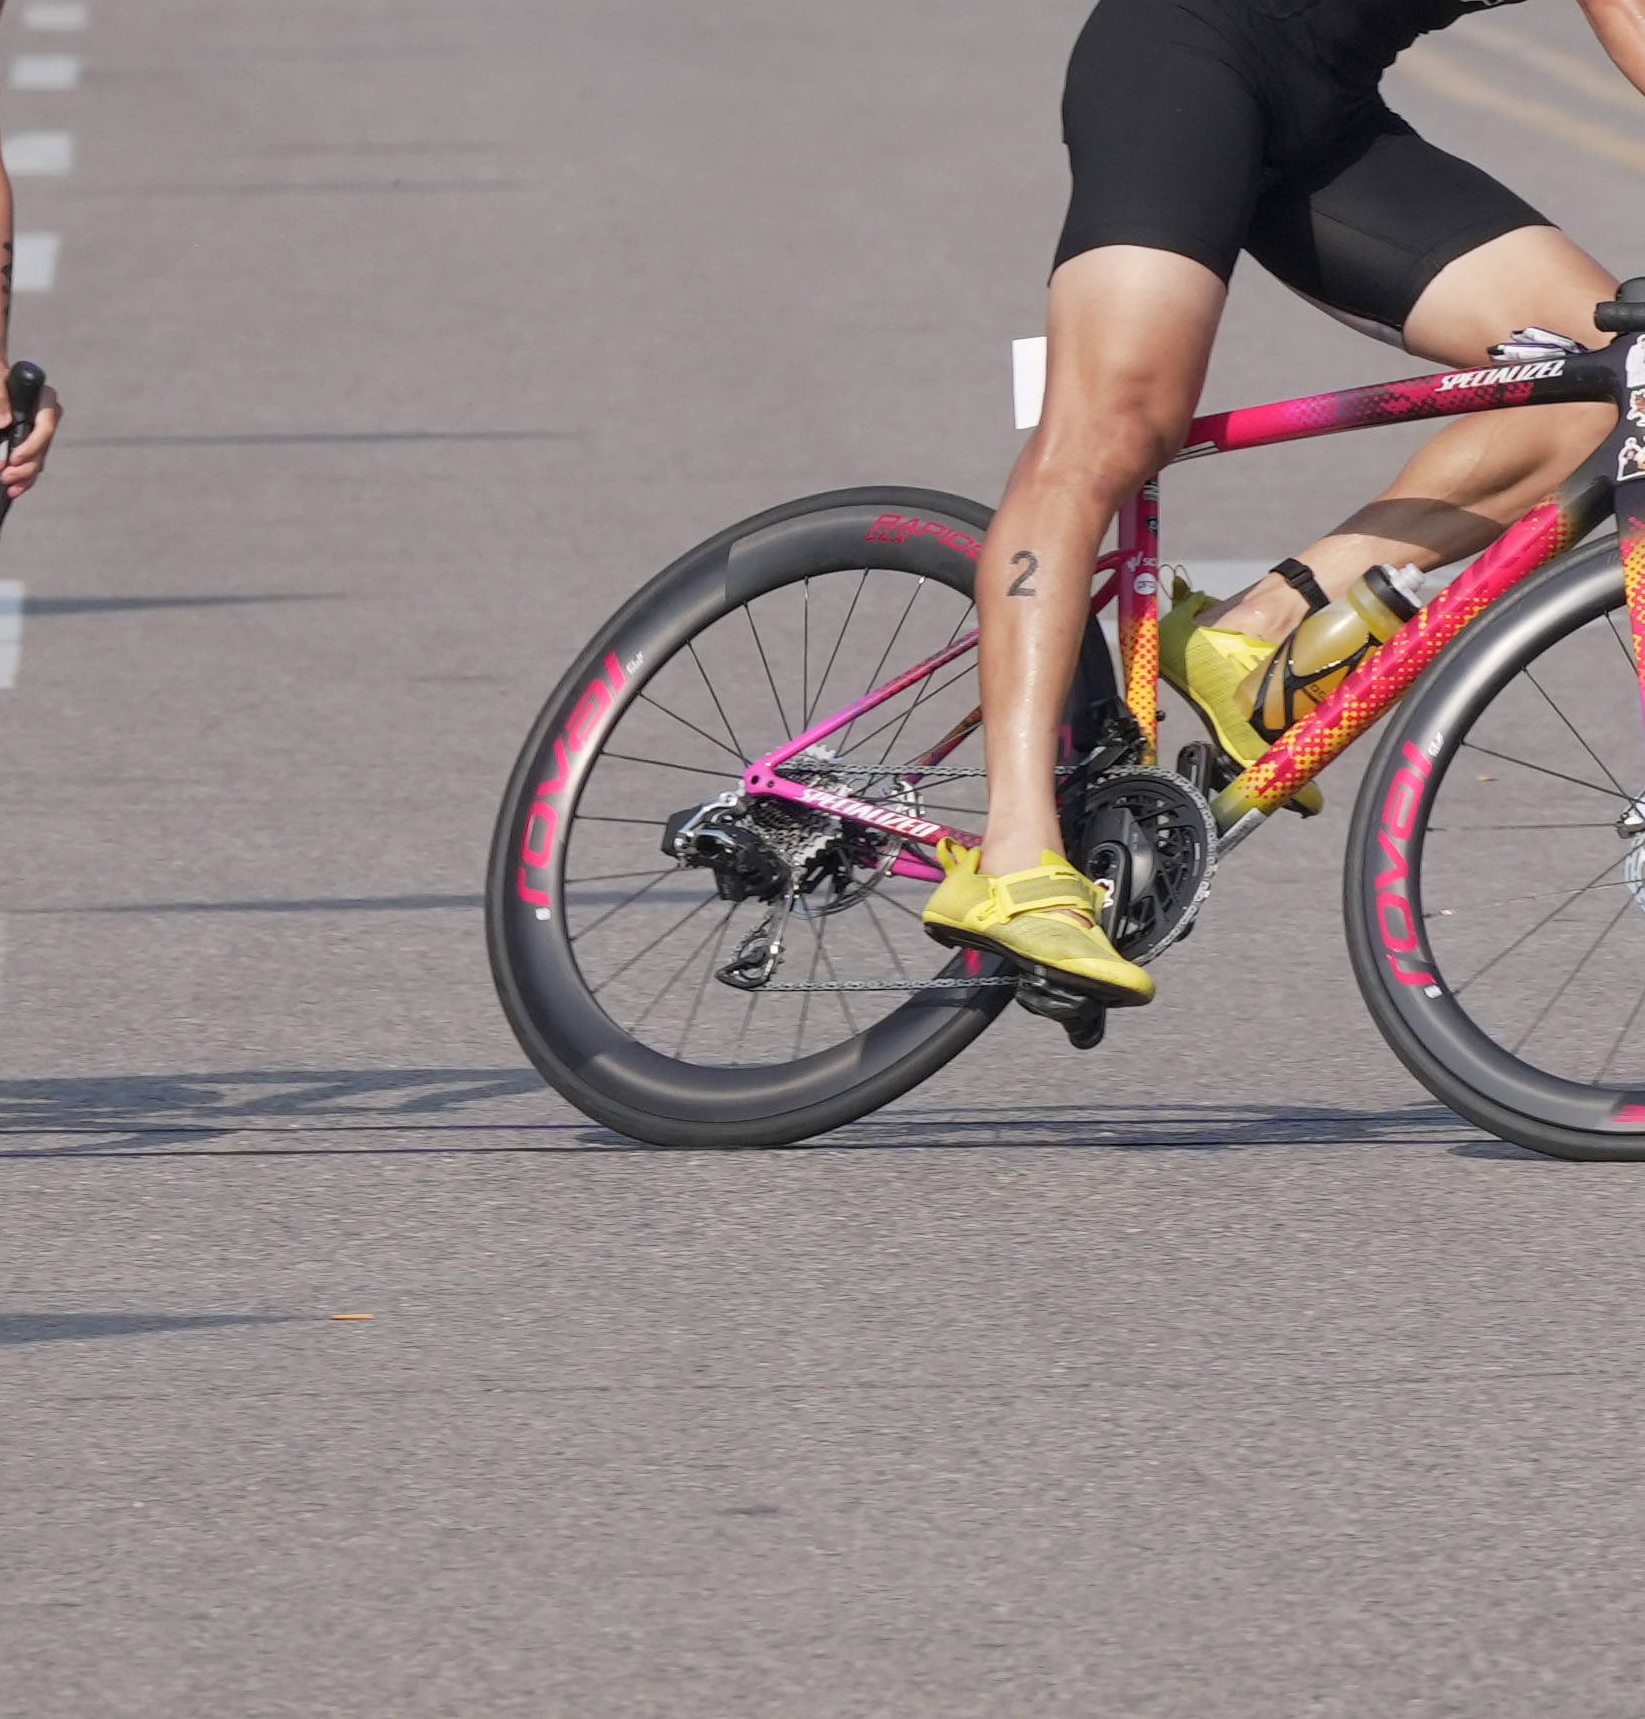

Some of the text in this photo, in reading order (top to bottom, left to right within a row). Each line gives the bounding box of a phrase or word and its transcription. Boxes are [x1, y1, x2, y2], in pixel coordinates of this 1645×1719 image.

[1006, 549, 1040, 598] 2
[517, 649, 635, 906] roval
[795, 787, 942, 838] SPECIALIZED
[1372, 740, 1435, 987] roval
